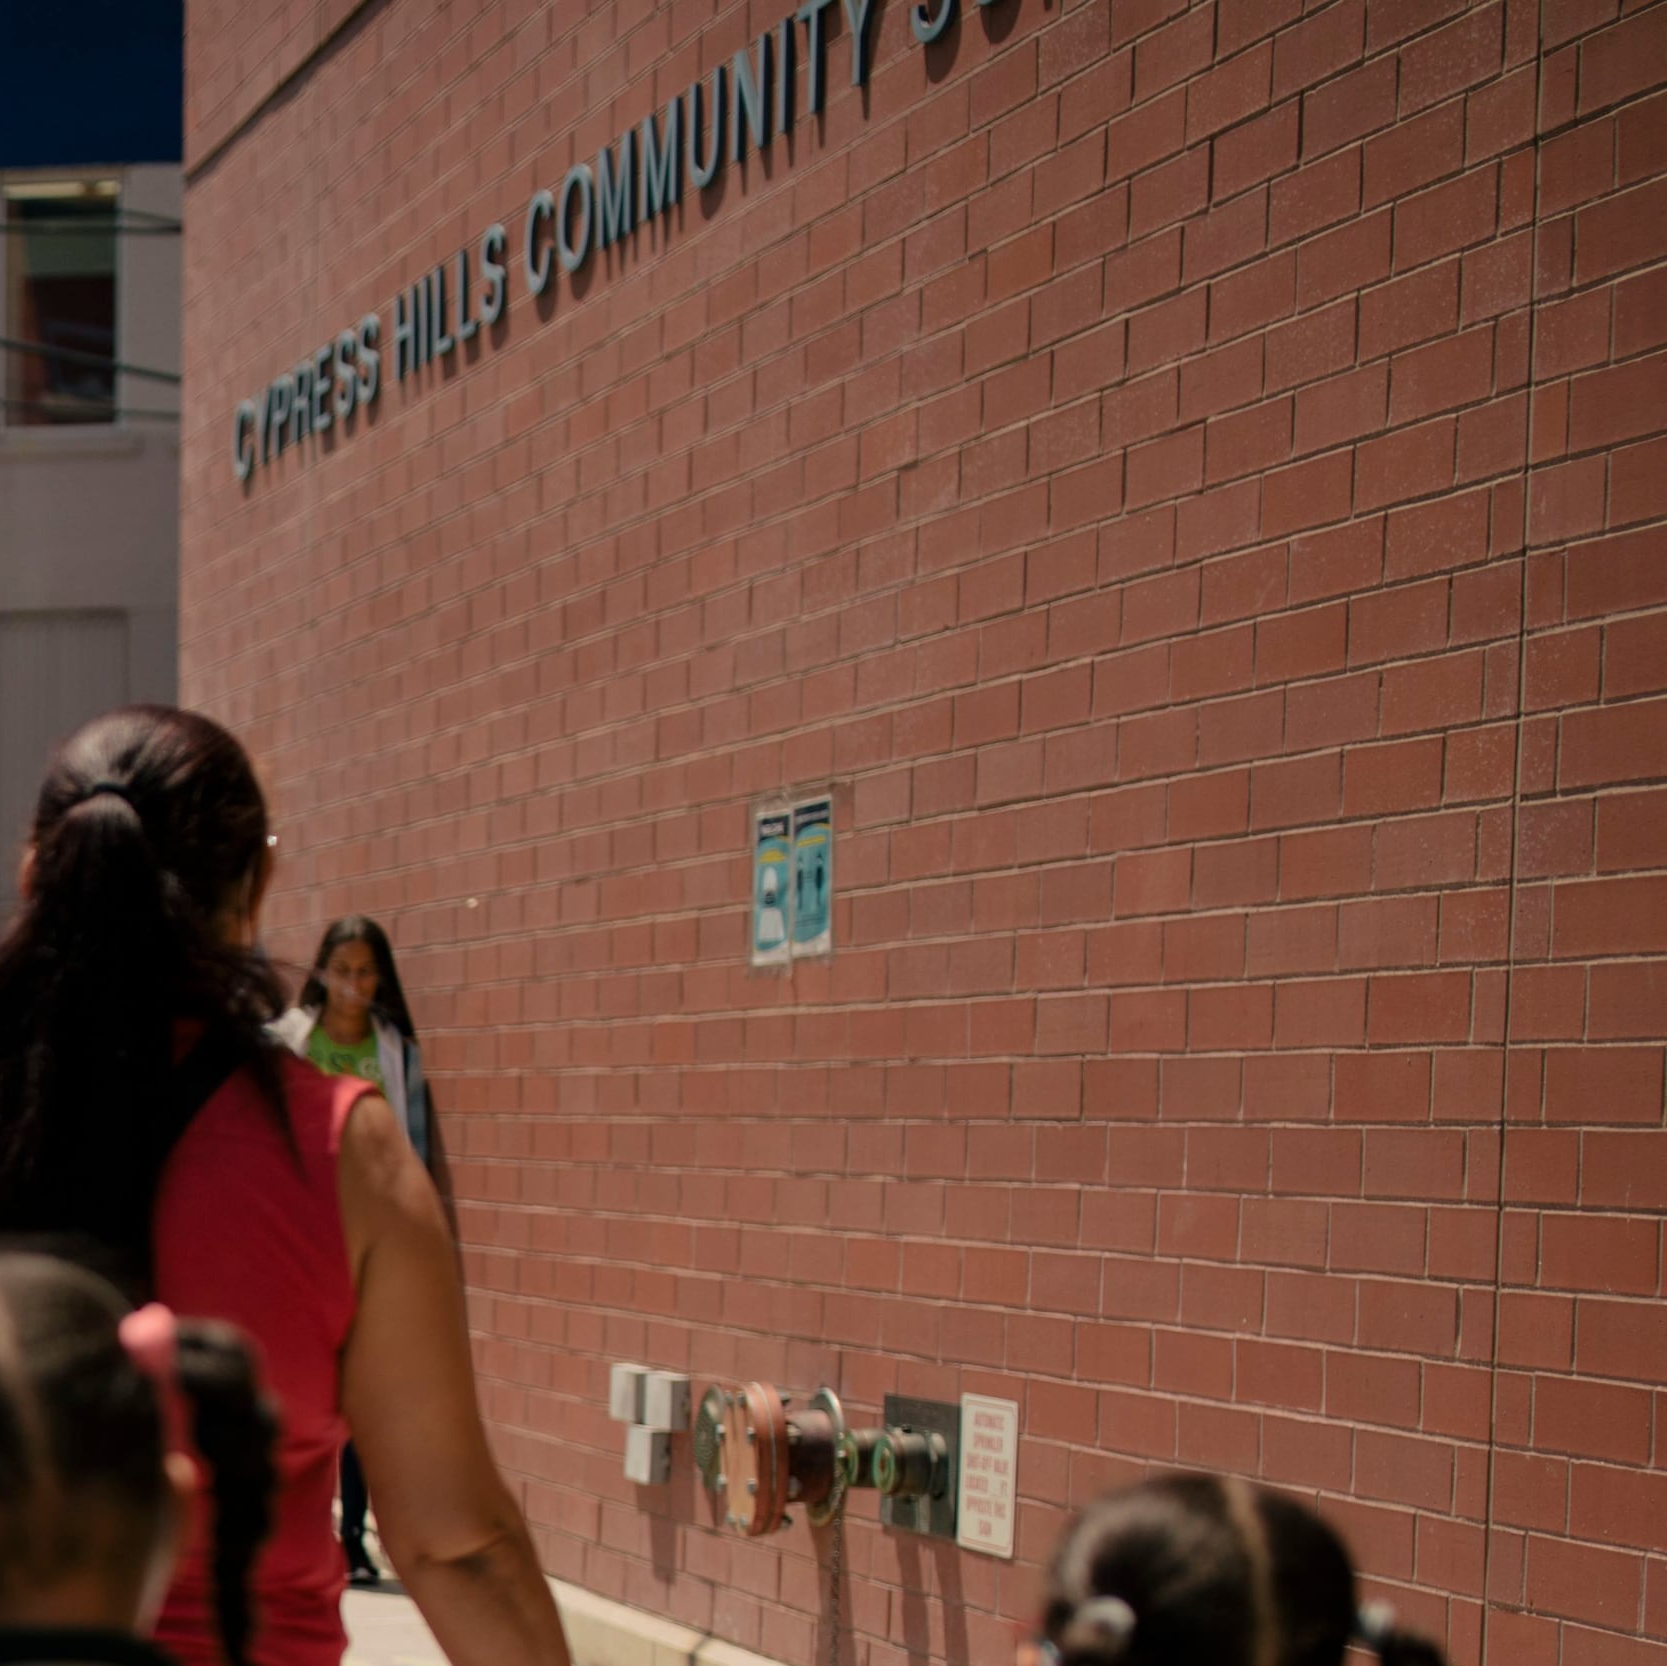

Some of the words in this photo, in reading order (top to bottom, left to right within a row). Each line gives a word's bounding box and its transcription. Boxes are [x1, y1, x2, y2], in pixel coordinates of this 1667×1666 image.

[234, 312, 380, 481] CYPRESS
[394, 223, 508, 382] HILLS
[524, 0, 873, 296] COMMUNITY
